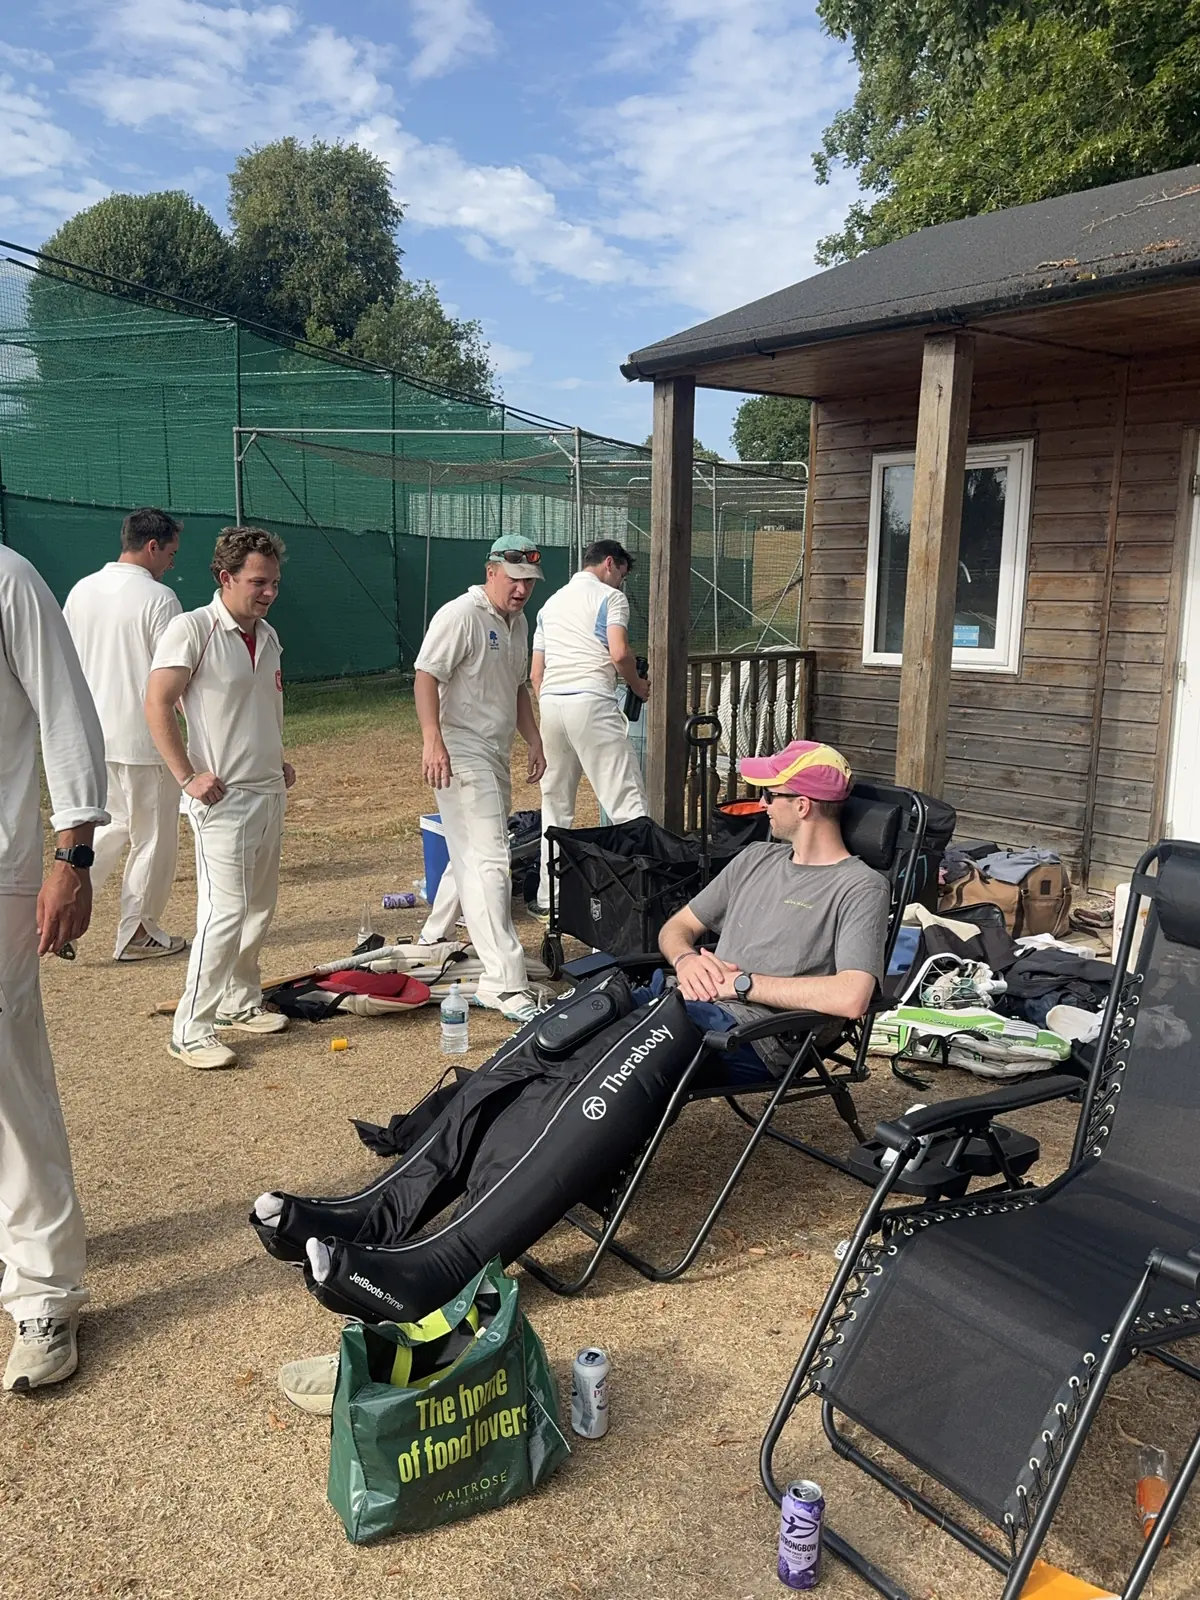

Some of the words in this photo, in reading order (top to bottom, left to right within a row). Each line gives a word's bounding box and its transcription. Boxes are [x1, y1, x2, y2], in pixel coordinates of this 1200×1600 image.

[599, 1024, 674, 1094] Therabody
[349, 1272, 384, 1299] JetBoots
[382, 1293, 404, 1311] Prime
[415, 1396, 457, 1431] The
[458, 1368, 508, 1419] home
[398, 1440, 421, 1483] of
[424, 1425, 472, 1475] food
[433, 1470, 507, 1504] WAITROSE
[455, 1491, 493, 1506] PARTNERS
[780, 1532, 817, 1552] STRONGBOW
